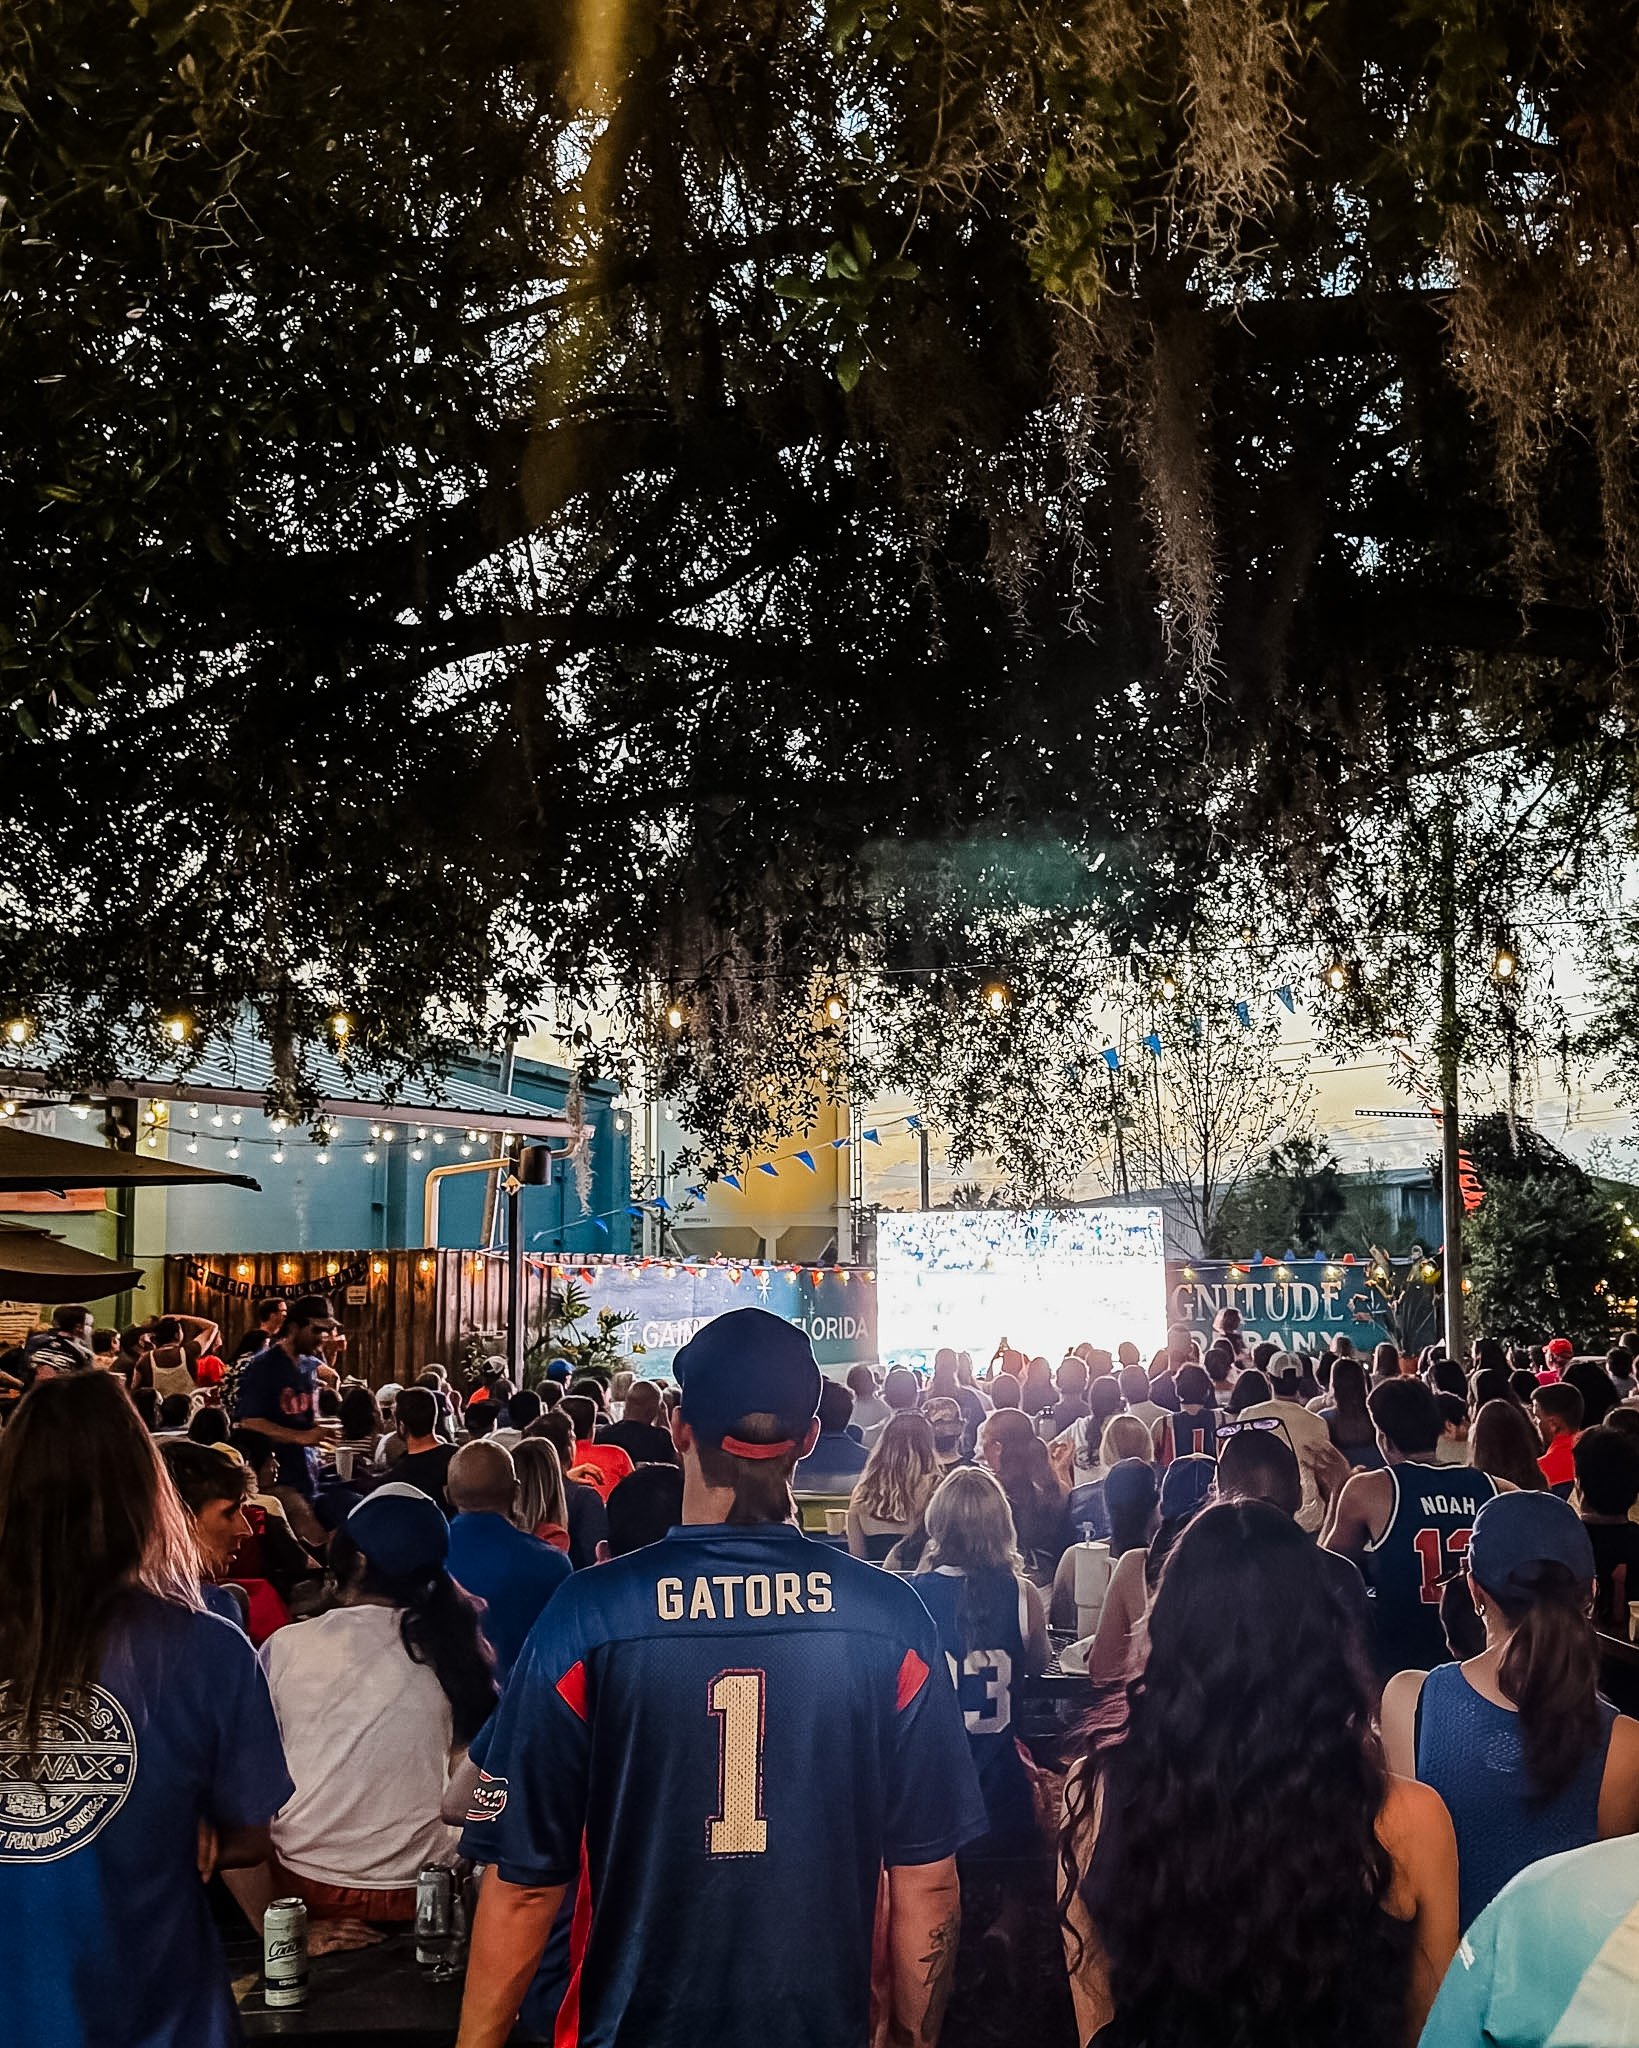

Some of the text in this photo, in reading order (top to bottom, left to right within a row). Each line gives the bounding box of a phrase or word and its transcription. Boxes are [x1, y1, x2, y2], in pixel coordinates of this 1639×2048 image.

[1420, 1495, 1476, 1516] NOAH
[656, 1571, 832, 1621] GATORS
[33, 1754, 117, 1781] WAX
[706, 1668, 770, 1860] 1
